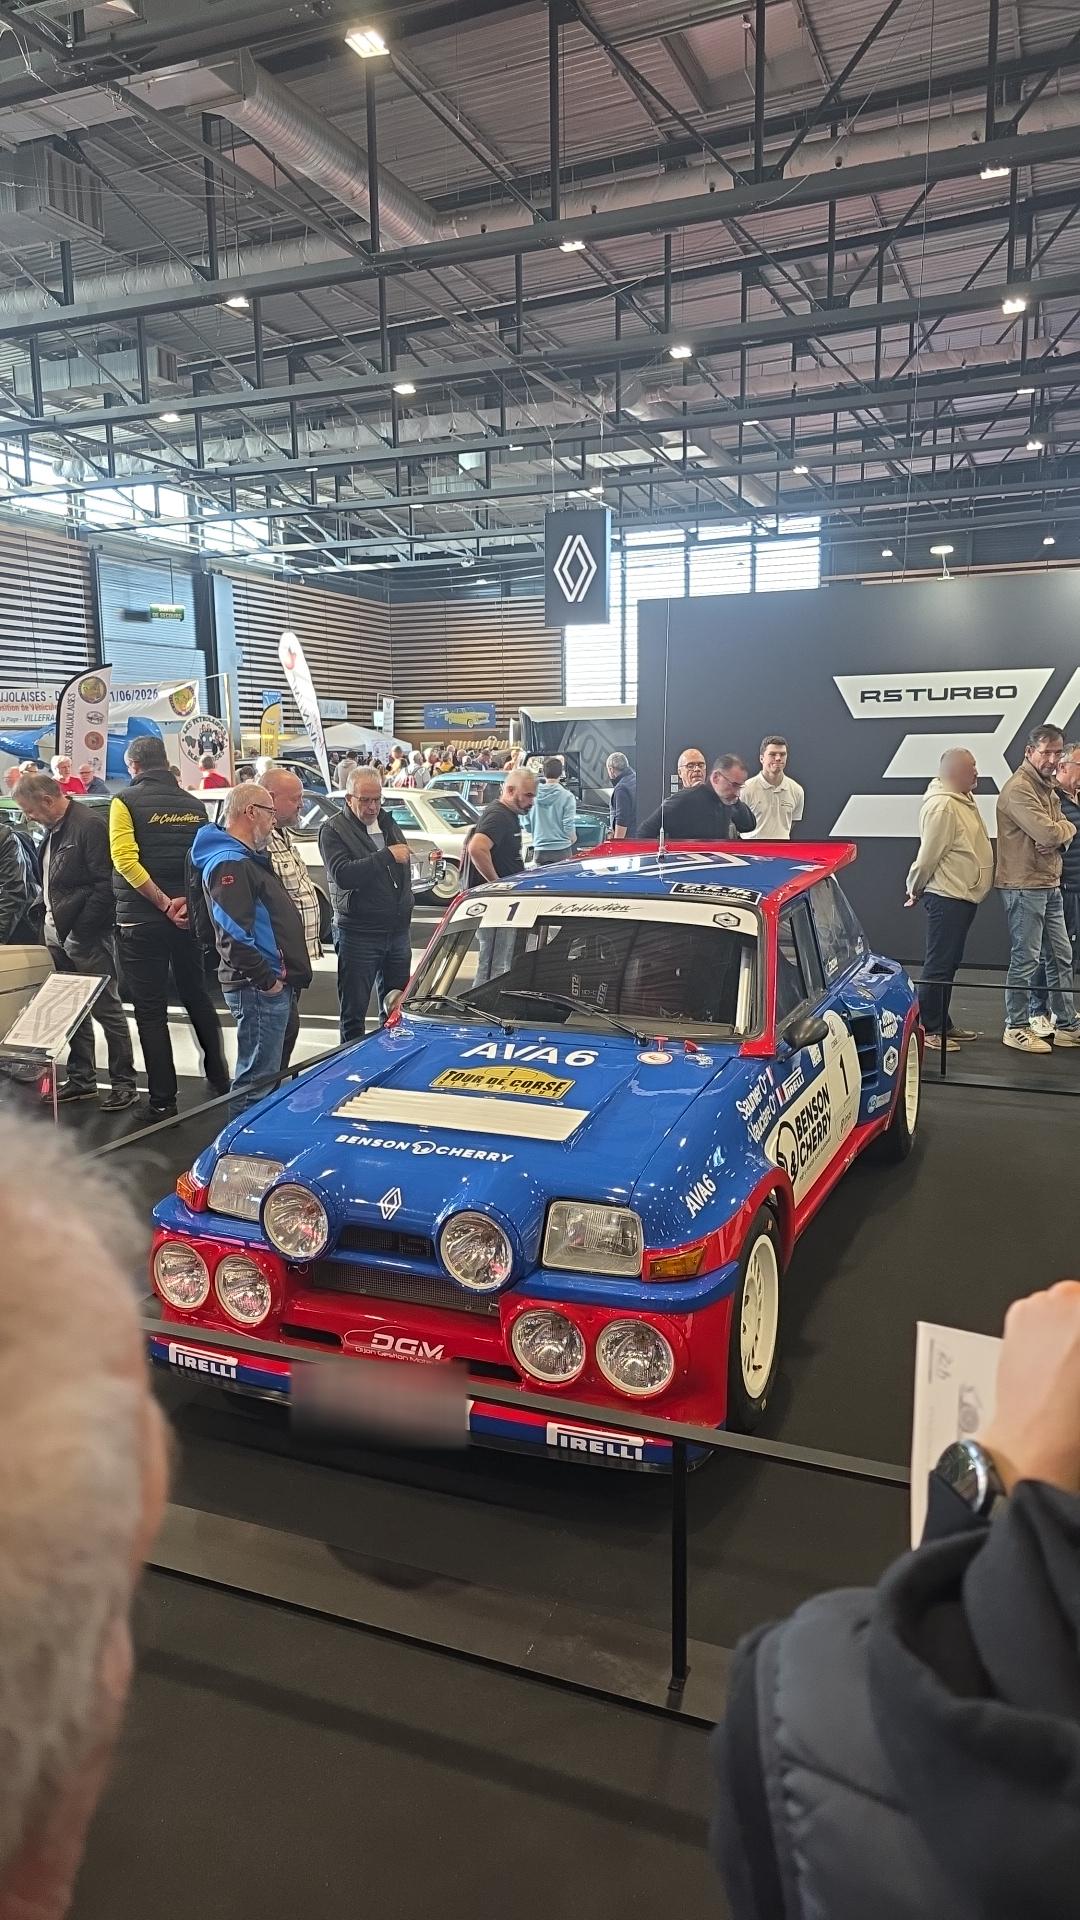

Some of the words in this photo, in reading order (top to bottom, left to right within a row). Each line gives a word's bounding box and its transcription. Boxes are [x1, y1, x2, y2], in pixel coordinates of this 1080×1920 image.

[506, 902, 520, 921] 1
[561, 902, 641, 914] Collection
[459, 1042, 599, 1067] AVA6
[444, 1070, 487, 1084] TOUR
[485, 1077, 508, 1086] DE
[509, 1079, 567, 1093] CORSE
[840, 1053, 849, 1096] 1
[795, 1083, 831, 1141] BENSON
[335, 1134, 410, 1150] BENSON
[435, 1146, 514, 1163] CHERRY
[800, 1108, 832, 1167] CHERRY
[685, 1173, 717, 1219] AVA6
[169, 1342, 238, 1379] PIRELLI
[370, 1332, 444, 1360] DGM
[546, 1422, 644, 1460] PIRELLI
